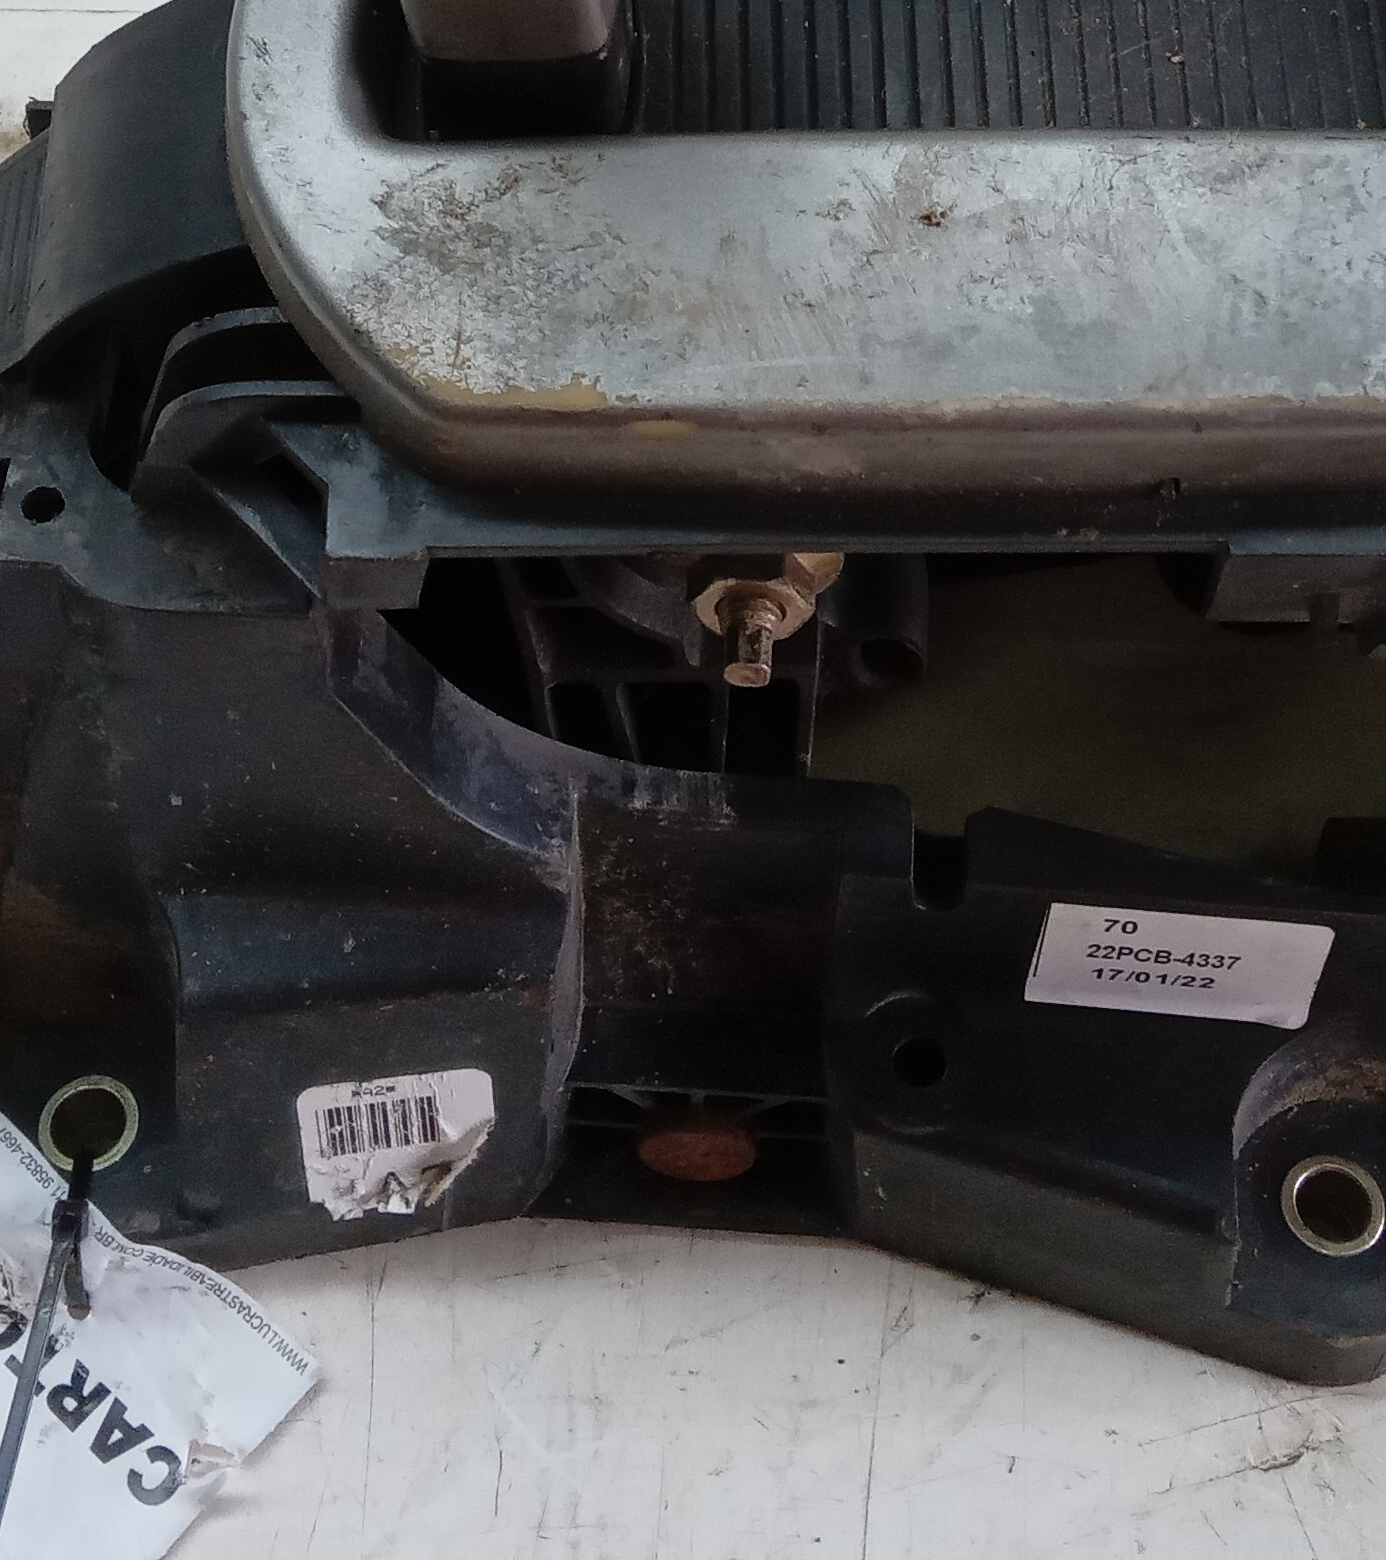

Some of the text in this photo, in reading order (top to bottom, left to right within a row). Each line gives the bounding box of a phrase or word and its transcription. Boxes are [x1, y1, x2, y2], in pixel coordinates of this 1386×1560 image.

[1102, 918, 1139, 935] 70
[1085, 943, 1242, 971] 22PCB-4337
[1091, 968, 1216, 989] 17/01/22
